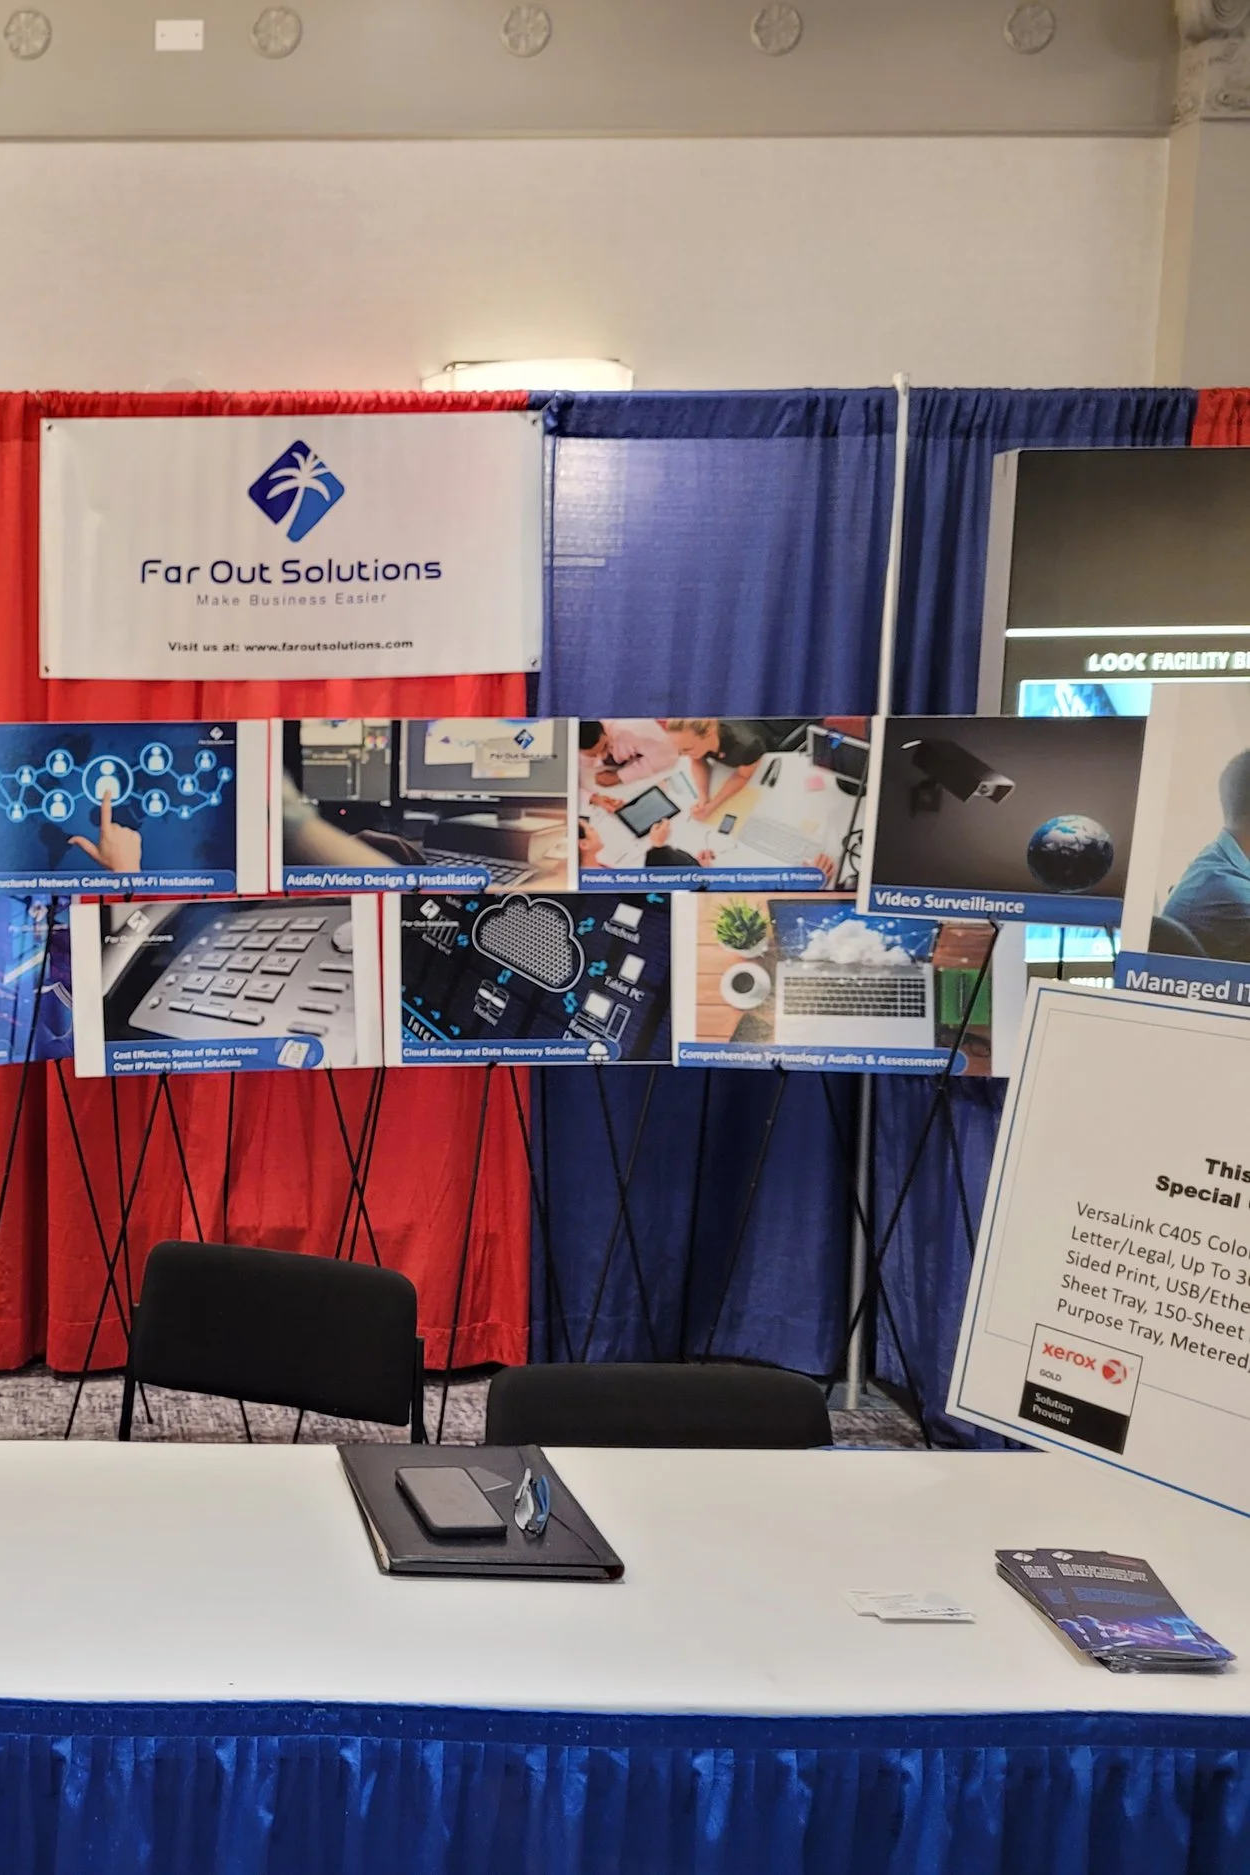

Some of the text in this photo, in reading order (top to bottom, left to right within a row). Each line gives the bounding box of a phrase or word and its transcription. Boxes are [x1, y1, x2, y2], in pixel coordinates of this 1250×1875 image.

[141, 558, 442, 584] Far Out Solutions
[197, 592, 386, 607] Make Business Easier
[168, 640, 413, 653] Visit us at: www.faroutsolutions.com
[1152, 651, 1230, 671] FACILITY
[38, 878, 80, 889] Network
[81, 877, 120, 890] Cabling
[122, 877, 129, 888] &
[131, 876, 157, 887] Wi-Fi
[159, 876, 214, 887] Installation
[286, 873, 486, 887] Audio/Video Design & Installation
[582, 872, 822, 885] Provide, Setup & Support of Computing Equipment & Printers
[875, 891, 1025, 914] Video Surveillance
[1125, 969, 1230, 1000] Managed
[113, 1047, 258, 1060] Cost Effective, State of the Art Voice
[403, 1046, 585, 1058] Cloud Backup and Data Recovery Solutions
[679, 1049, 762, 1062] Comprehensive
[827, 1053, 863, 1065] Audits
[865, 1055, 875, 1065] &
[877, 1055, 951, 1068] Assessments
[114, 1059, 242, 1072] Over IP Phone System Solutions
[1155, 1175, 1241, 1209] Special
[1076, 1201, 1154, 1235] VersaLink
[1159, 1223, 1202, 1246] C405
[1071, 1225, 1175, 1270] Letter/Legal,
[1181, 1254, 1205, 1276] Up
[1211, 1262, 1231, 1280] To
[1065, 1250, 1111, 1275] Sided
[1116, 1264, 1160, 1292] Print,
[1062, 1274, 1246, 1341] Sheet Tray, 150-Sheet
[1057, 1298, 1124, 1331] Purpose
[1128, 1319, 1165, 1346] Tray,
[1042, 1342, 1097, 1371] xerox
[1039, 1368, 1062, 1382] GOLD
[1035, 1391, 1074, 1414] Solution
[1032, 1403, 1071, 1425] Provider
